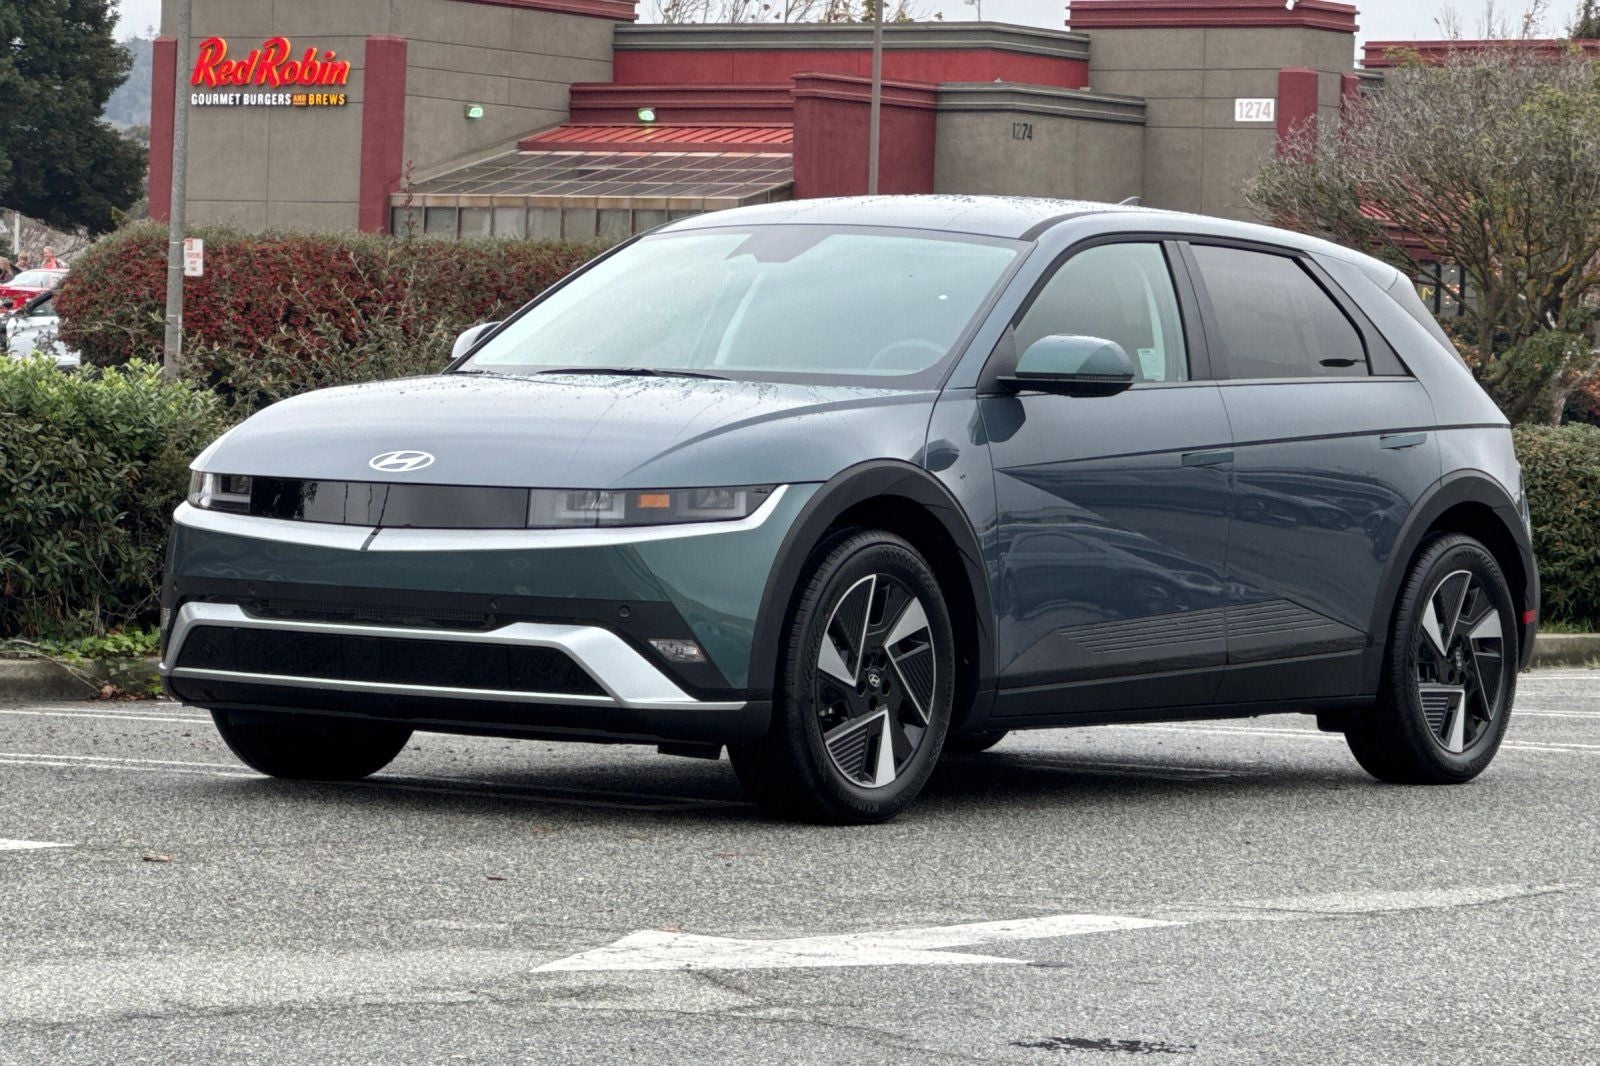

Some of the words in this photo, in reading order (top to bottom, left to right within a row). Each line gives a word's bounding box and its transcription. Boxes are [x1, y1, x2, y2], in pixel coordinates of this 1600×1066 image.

[191, 37, 261, 87] Red
[254, 37, 350, 87] Robin
[191, 93, 241, 105] GOURMET
[243, 93, 292, 105] BURGERS
[293, 94, 306, 103] AND
[308, 93, 345, 105] BREWS
[1238, 101, 1272, 119] 1274
[1012, 122, 1033, 142] 1274
